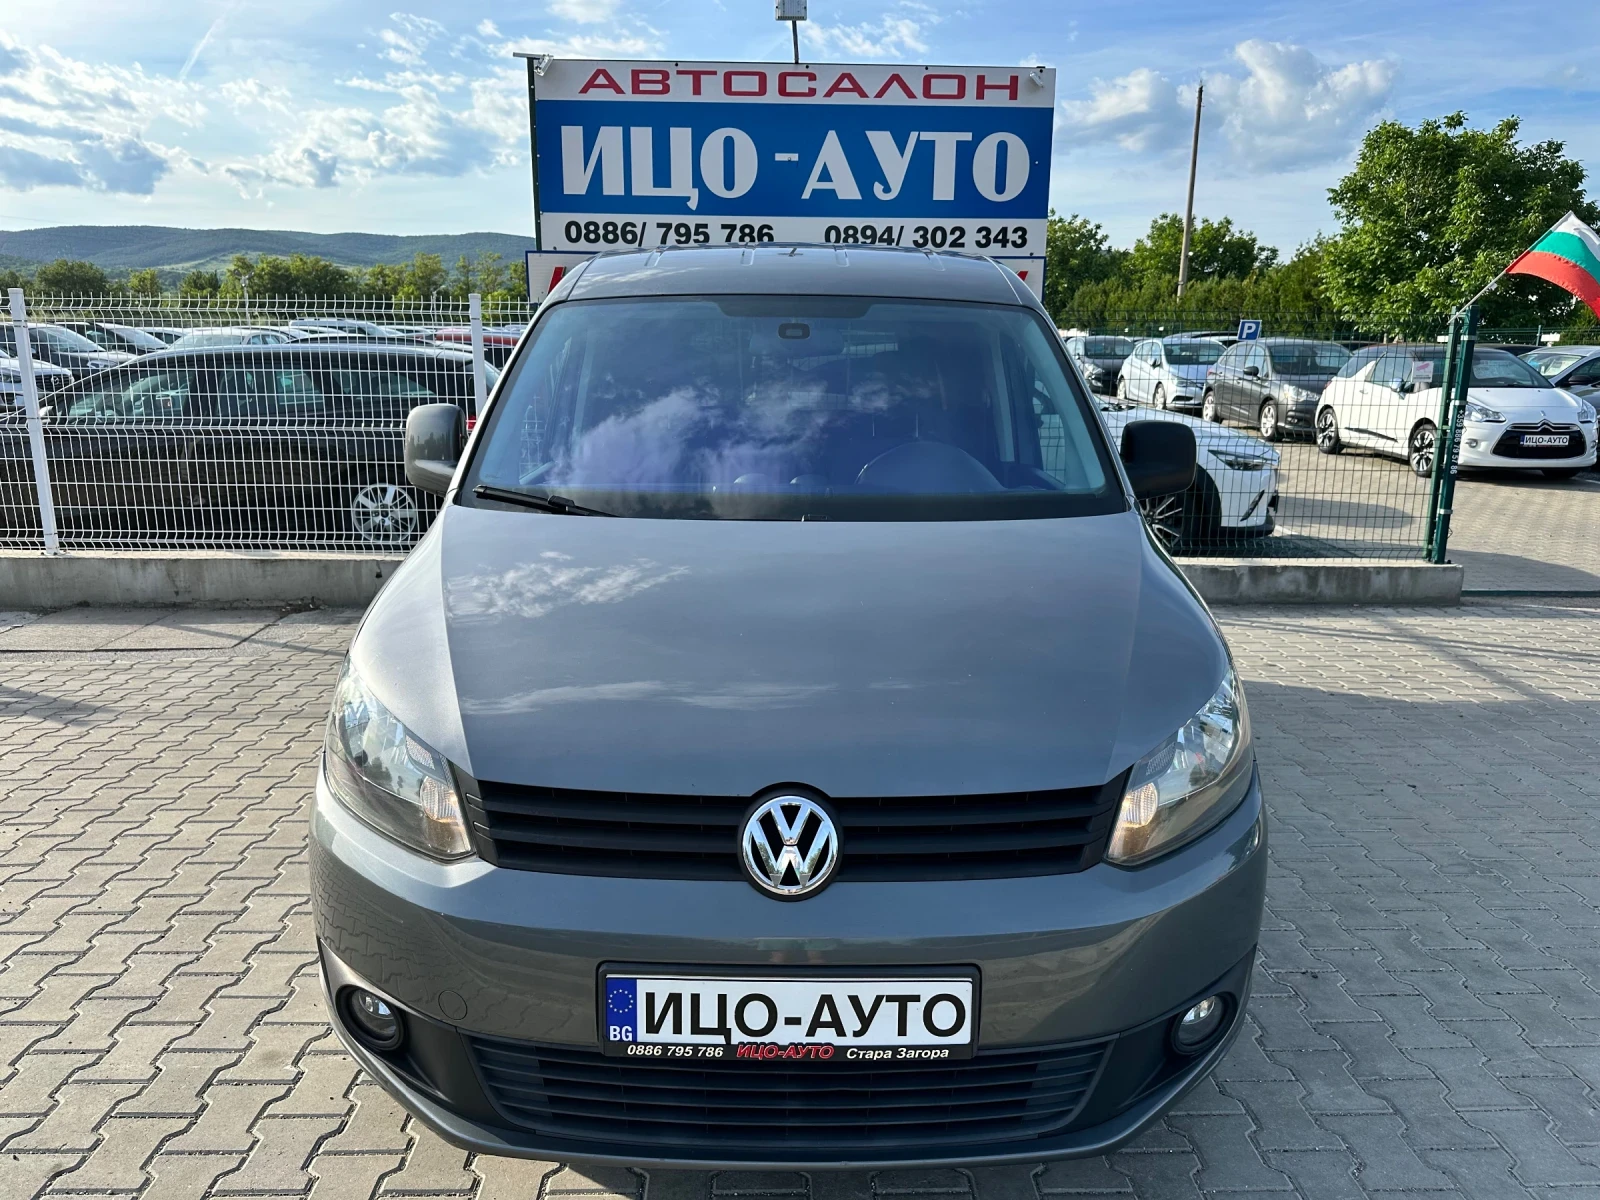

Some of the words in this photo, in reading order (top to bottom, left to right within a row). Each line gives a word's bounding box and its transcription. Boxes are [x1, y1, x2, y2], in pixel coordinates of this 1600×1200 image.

[579, 68, 1019, 100] АВТОСАЛОН
[565, 221, 647, 247] 0886/
[656, 223, 710, 244] 795
[720, 224, 774, 242] 786
[825, 225, 904, 246] 0894/
[912, 226, 966, 248] 302
[975, 227, 1028, 248] 343
[1242, 323, 1256, 338] P
[1525, 436, 1569, 445] ИЦО-АУТО
[746, 798, 835, 893] VW
[644, 991, 967, 1044] ИЦО-АУТО
[609, 1026, 633, 1041] BG
[627, 1044, 662, 1056] 0886
[667, 1046, 693, 1057] 795
[697, 1047, 724, 1058] 786
[736, 1044, 835, 1060] ИЦО-АУТО
[846, 1047, 892, 1060] Стара
[896, 1047, 949, 1060] Загора
